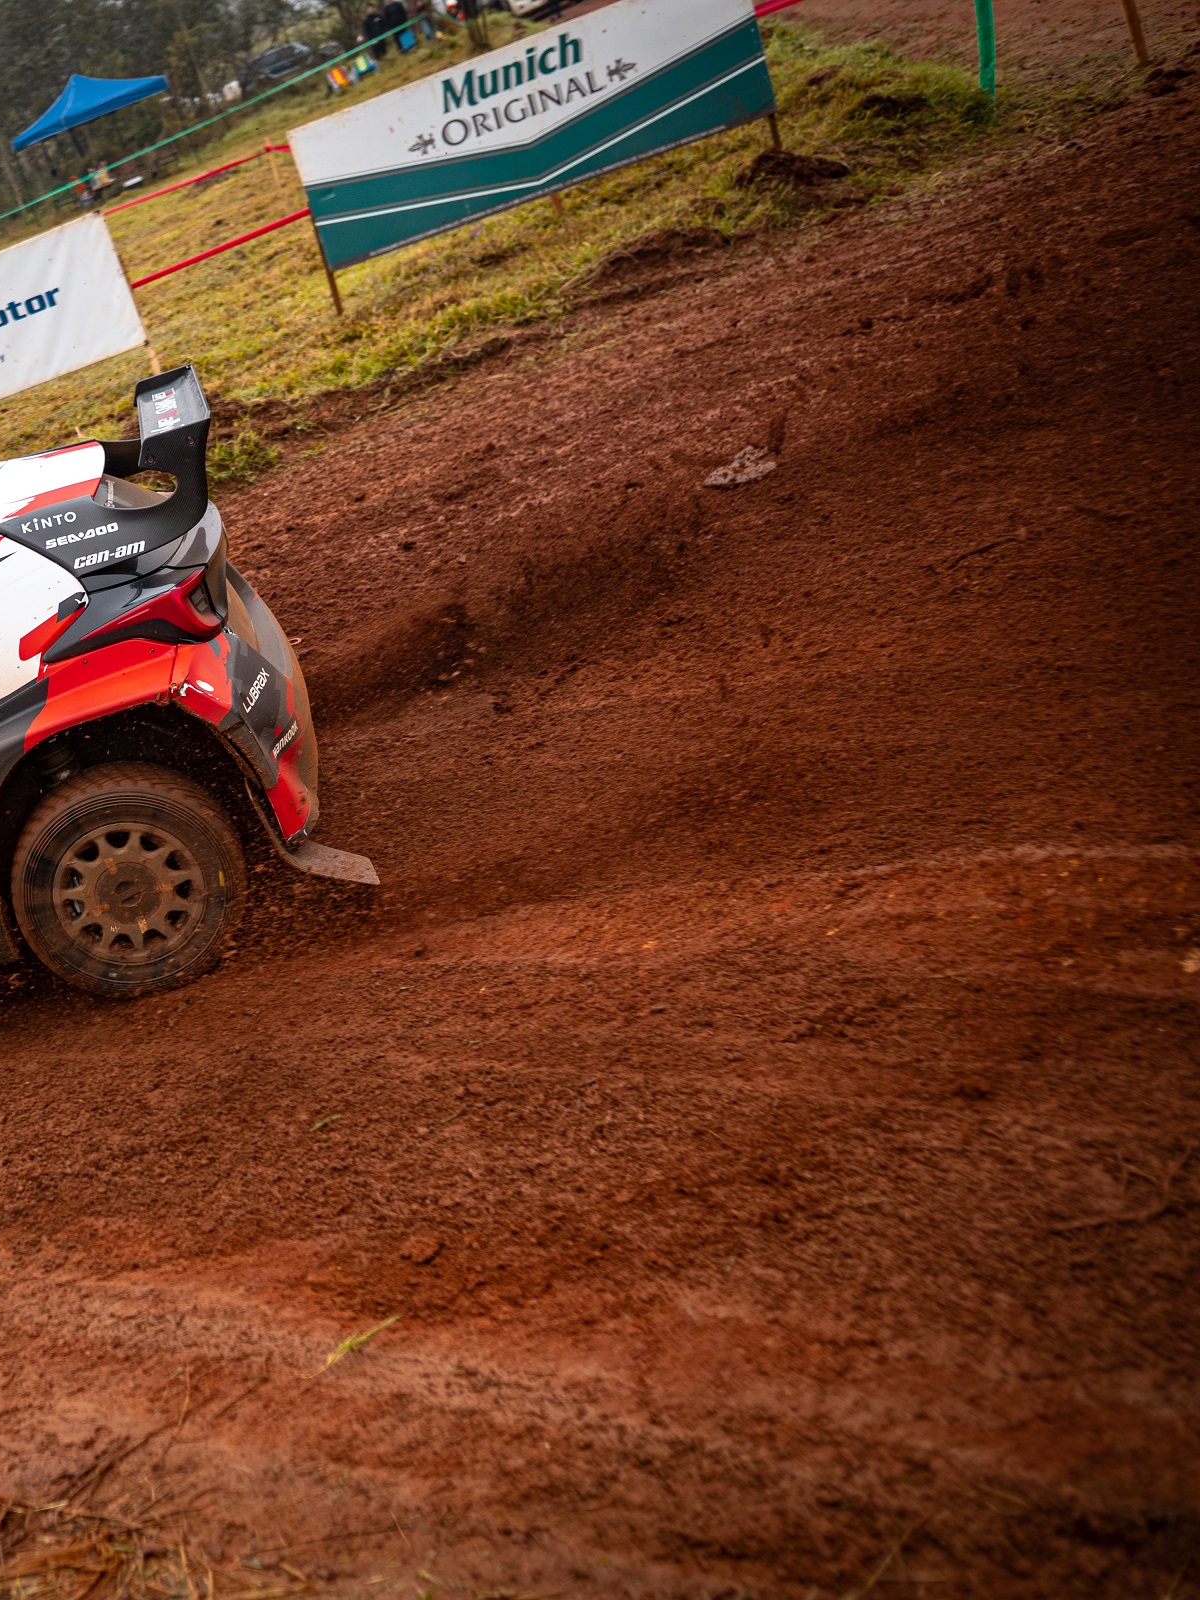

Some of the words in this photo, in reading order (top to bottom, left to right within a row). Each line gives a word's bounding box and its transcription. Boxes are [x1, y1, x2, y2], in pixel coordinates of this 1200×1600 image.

[441, 32, 584, 114] Munich
[441, 70, 607, 148] ORIGINAL
[73, 540, 146, 570] can-am
